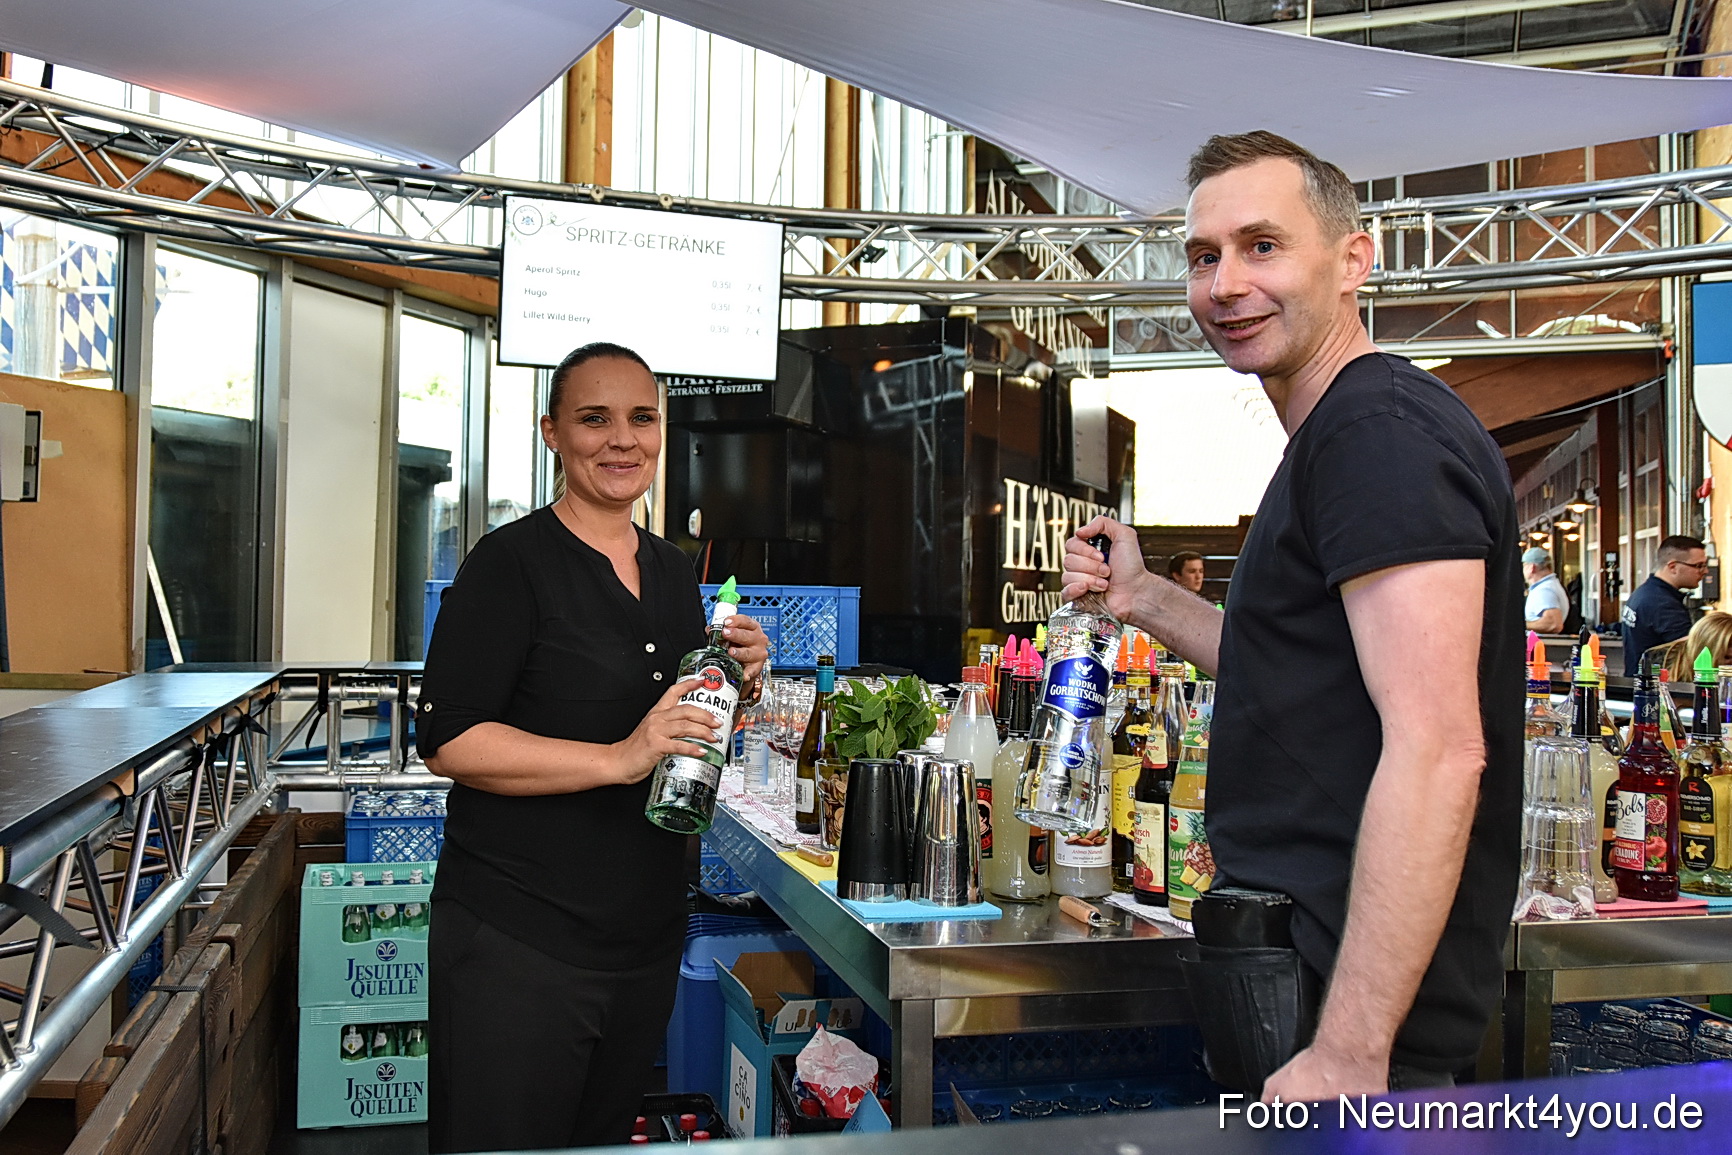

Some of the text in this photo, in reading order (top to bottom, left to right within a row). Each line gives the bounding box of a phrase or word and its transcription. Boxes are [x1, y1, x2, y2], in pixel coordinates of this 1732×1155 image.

[565, 226, 726, 256] SPRITZ-GETRÄNKE
[525, 264, 581, 277] Aperol Spritz
[524, 287, 547, 298] Hugo
[523, 310, 591, 325] Lillet Wild Berry
[715, 383, 764, 395] FESTZELTE
[1001, 581, 1063, 624] GETRÄNK
[1068, 677, 1097, 692] WODKA
[1050, 684, 1106, 707] GORBATSCHOW
[344, 957, 425, 982] JESUITEN
[350, 978, 418, 999] QUELLE
[738, 1065, 748, 1084] CA
[344, 1077, 425, 1101] JESUITEN
[734, 1082, 751, 1110] CINO
[350, 1097, 418, 1119] QUELLE
